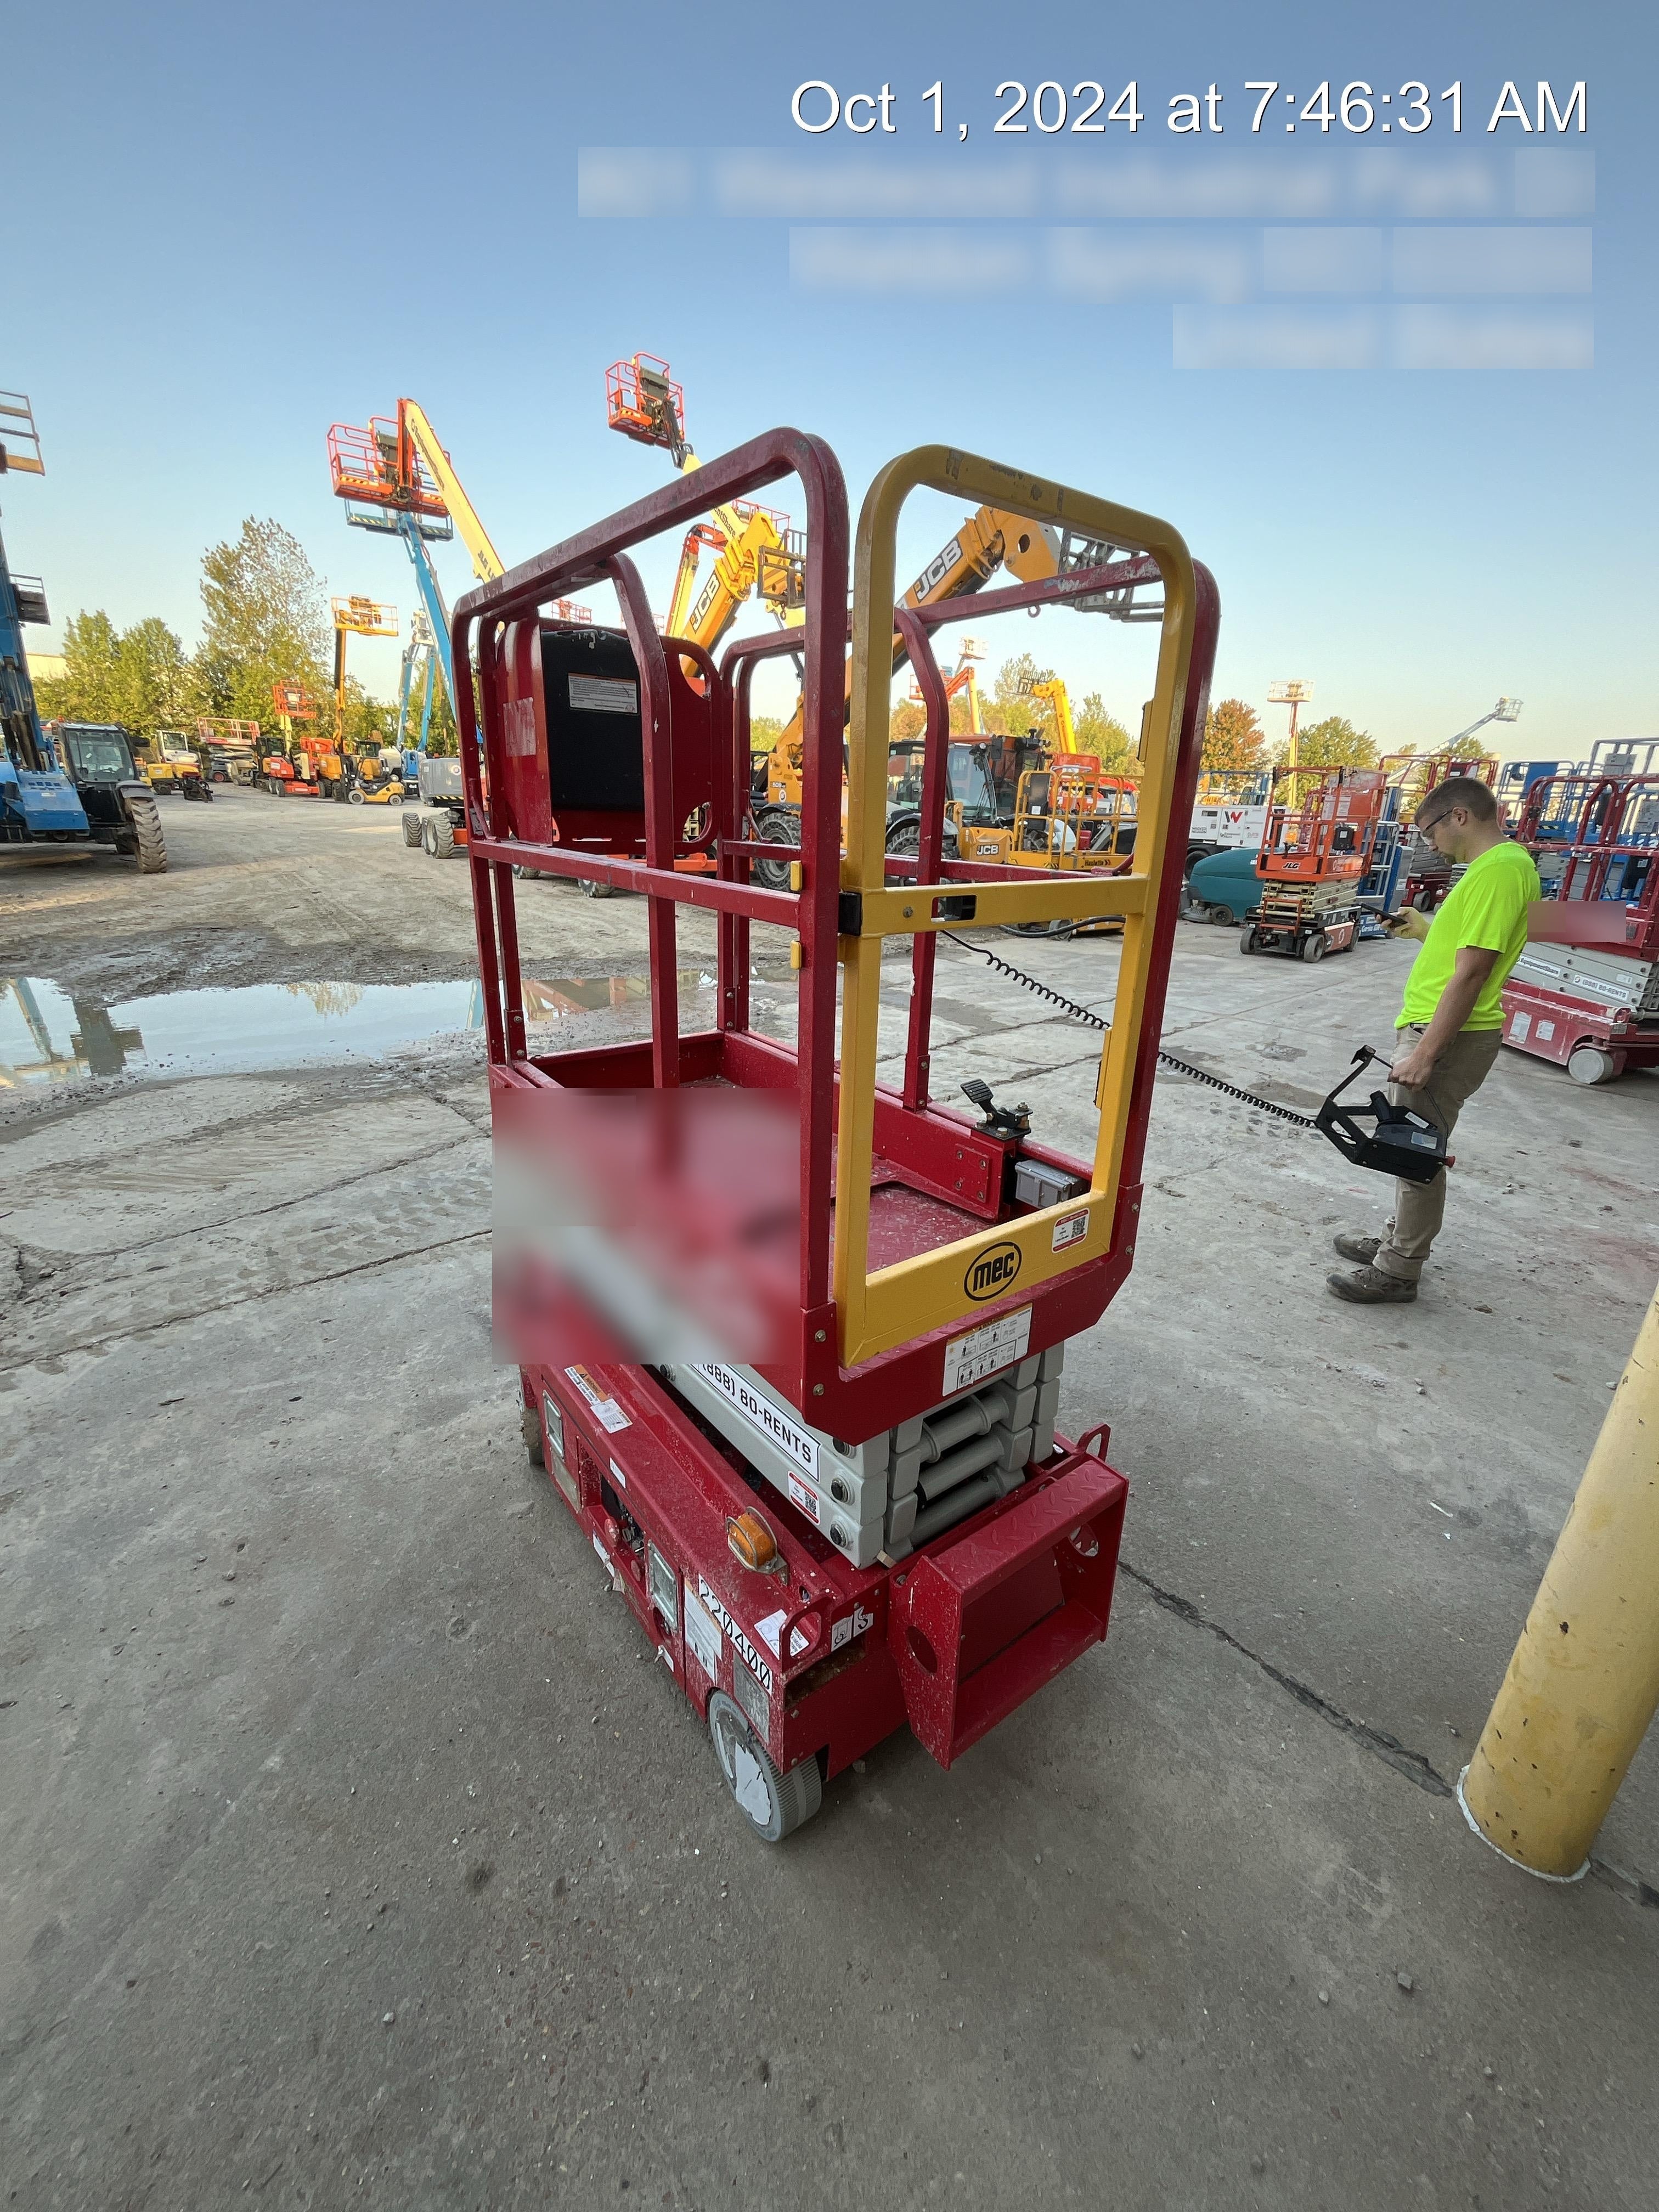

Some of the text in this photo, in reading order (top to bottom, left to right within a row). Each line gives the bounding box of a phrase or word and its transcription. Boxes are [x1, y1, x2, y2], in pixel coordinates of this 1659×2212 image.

[917, 540, 962, 600] JCB
[692, 574, 720, 631] JCB
[977, 845, 998, 855] JCB
[1598, 984, 1627, 998] 80-RENTS
[740, 1388, 811, 1464] 80-RENTS
